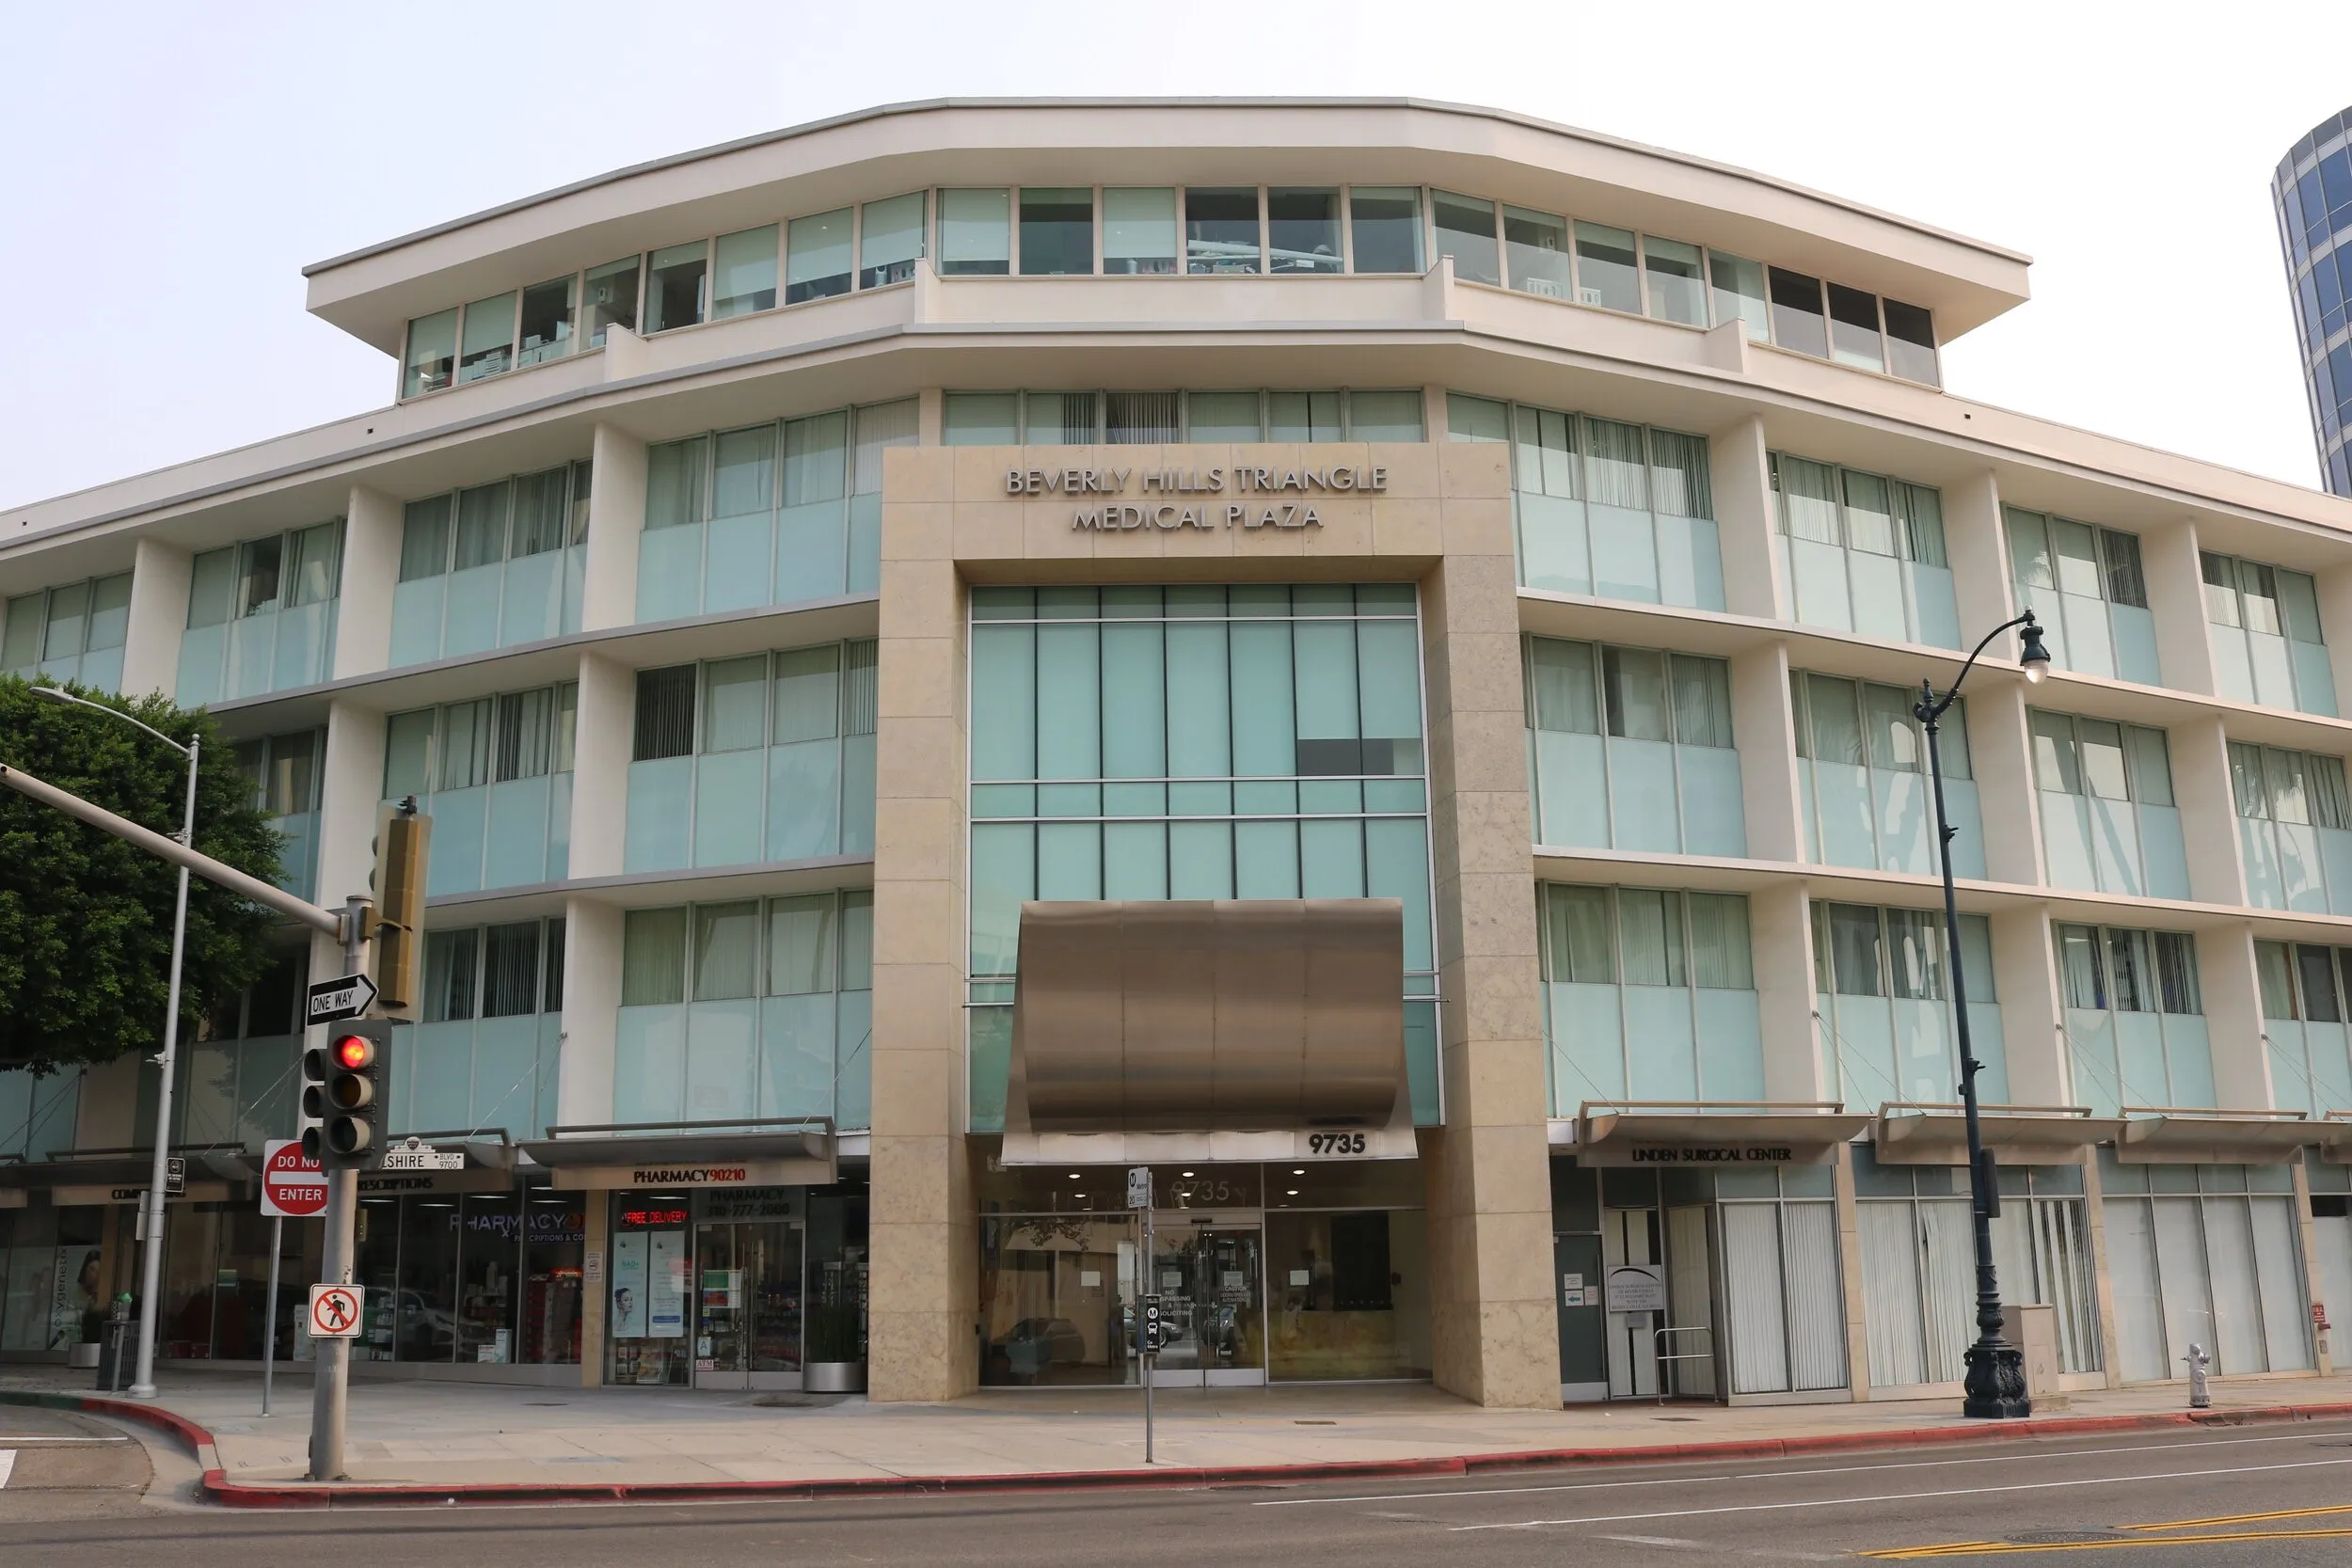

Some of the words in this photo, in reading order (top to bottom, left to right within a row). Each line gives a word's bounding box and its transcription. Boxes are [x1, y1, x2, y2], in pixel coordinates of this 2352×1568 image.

[1007, 467, 1132, 494] BEVERLY
[1143, 466, 1225, 492] HILLS
[1234, 465, 1387, 491] TRIANGLE
[1073, 504, 1215, 530] MEDICAL
[1226, 503, 1324, 528] PLAZA
[313, 996, 330, 1012] ONE
[335, 990, 354, 1007] WAY
[1309, 1132, 1366, 1154] 9735
[278, 1155, 296, 1167] DO
[301, 1156, 320, 1168] NO
[383, 1155, 425, 1168] SHIRE
[438, 1161, 458, 1169] 9700
[1632, 1148, 1678, 1162] LINDEN
[1682, 1148, 1742, 1162] SURGICAL
[1746, 1147, 1792, 1161] CENTER
[278, 1188, 323, 1201] ENTER
[709, 1189, 785, 1201] PHARMACY
[1170, 1180, 1230, 1201] 9735
[628, 1212, 646, 1224] FREE
[650, 1211, 688, 1223] DELIVERY
